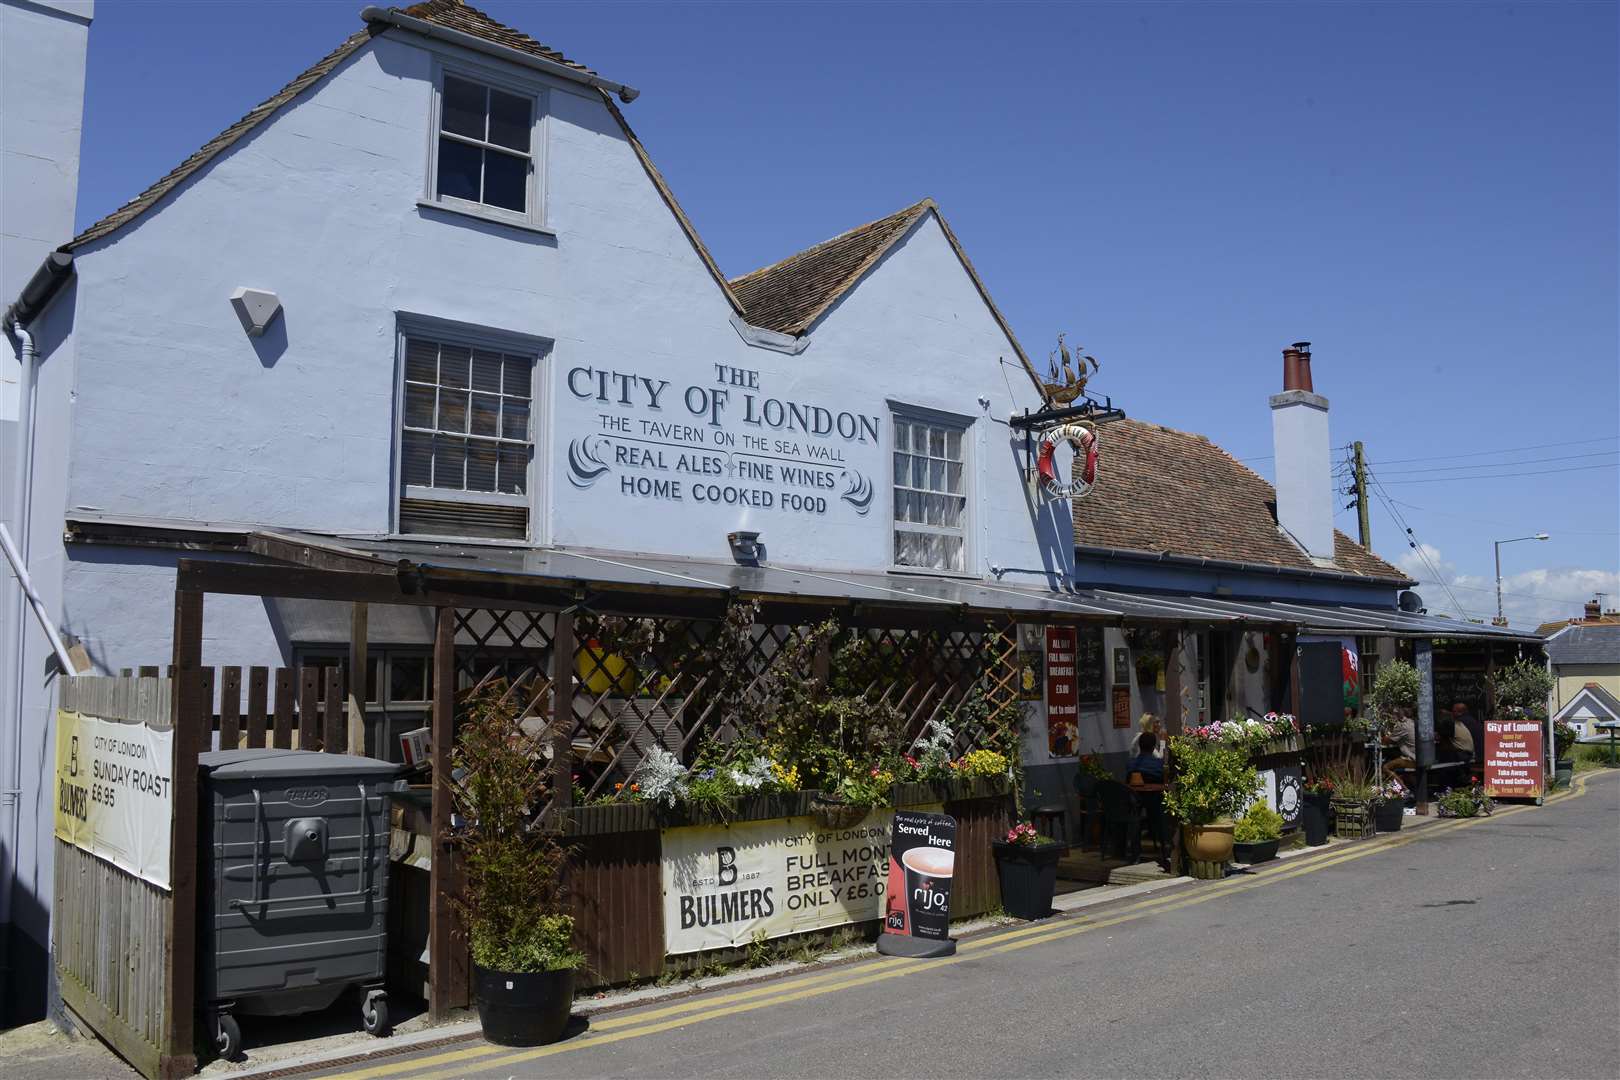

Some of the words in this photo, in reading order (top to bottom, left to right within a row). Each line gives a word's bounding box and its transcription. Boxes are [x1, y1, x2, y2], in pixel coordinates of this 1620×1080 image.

[714, 362, 760, 390] THE
[567, 365, 670, 409] CITY
[684, 386, 729, 427] OF
[743, 394, 880, 445] LONDON
[599, 414, 632, 433] THE
[639, 420, 704, 443] TAVERN
[714, 431, 735, 447] ON
[743, 435, 769, 451] THE
[775, 440, 801, 456] SEA
[807, 444, 846, 462] WALL
[615, 445, 668, 469] REAL
[676, 454, 722, 475] ALES
[739, 461, 774, 481] FINE
[780, 466, 835, 488] WINES
[621, 475, 682, 499] HOME
[692, 484, 773, 507] COOKED
[781, 493, 827, 514] FOOD
[1487, 722, 1502, 733] City
[1503, 722, 1511, 732] of
[1513, 722, 1539, 732] London
[94, 736, 108, 751] CITY
[108, 739, 117, 753] OF
[117, 741, 147, 760] LONDON
[93, 759, 131, 788] SUNDAY
[132, 769, 170, 799] ROAST
[60, 777, 88, 822] BULMERS
[92, 783, 115, 807] £6.95
[785, 835, 814, 848] CITY
[817, 833, 833, 844] OF
[836, 827, 885, 842] LONDON
[898, 822, 929, 836] Served
[928, 835, 952, 847] Here
[717, 846, 738, 887] B
[786, 852, 838, 872] FULL
[842, 844, 891, 865] MON
[742, 872, 760, 880] 1887
[787, 862, 890, 892] BREAKFAS
[680, 886, 775, 930] BULMERS
[787, 887, 842, 911] ONLY
